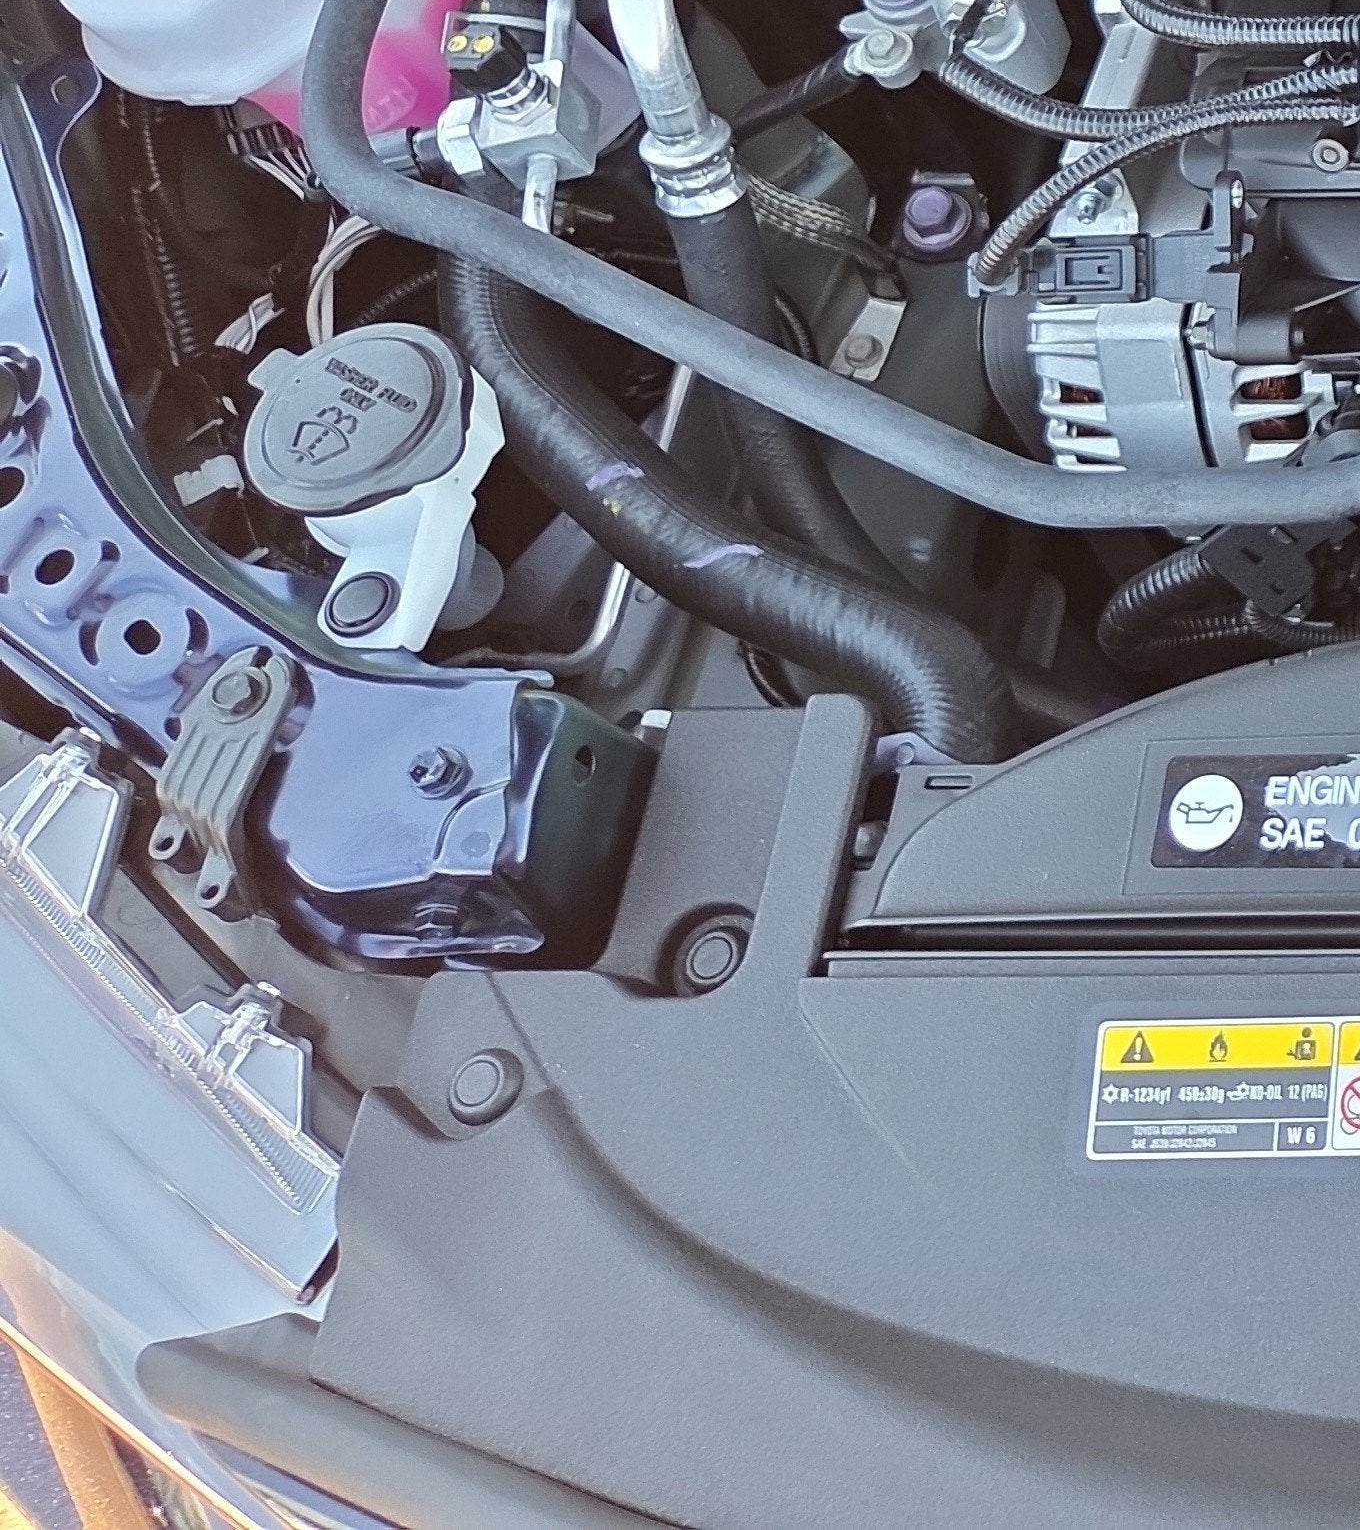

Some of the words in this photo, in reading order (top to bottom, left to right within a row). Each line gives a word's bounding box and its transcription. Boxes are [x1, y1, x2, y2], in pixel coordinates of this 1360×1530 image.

[1260, 817, 1326, 849] SAE
[1288, 1084, 1299, 1100] 12
[1286, 1127, 1301, 1144] W
[1305, 1126, 1315, 1143] 6
